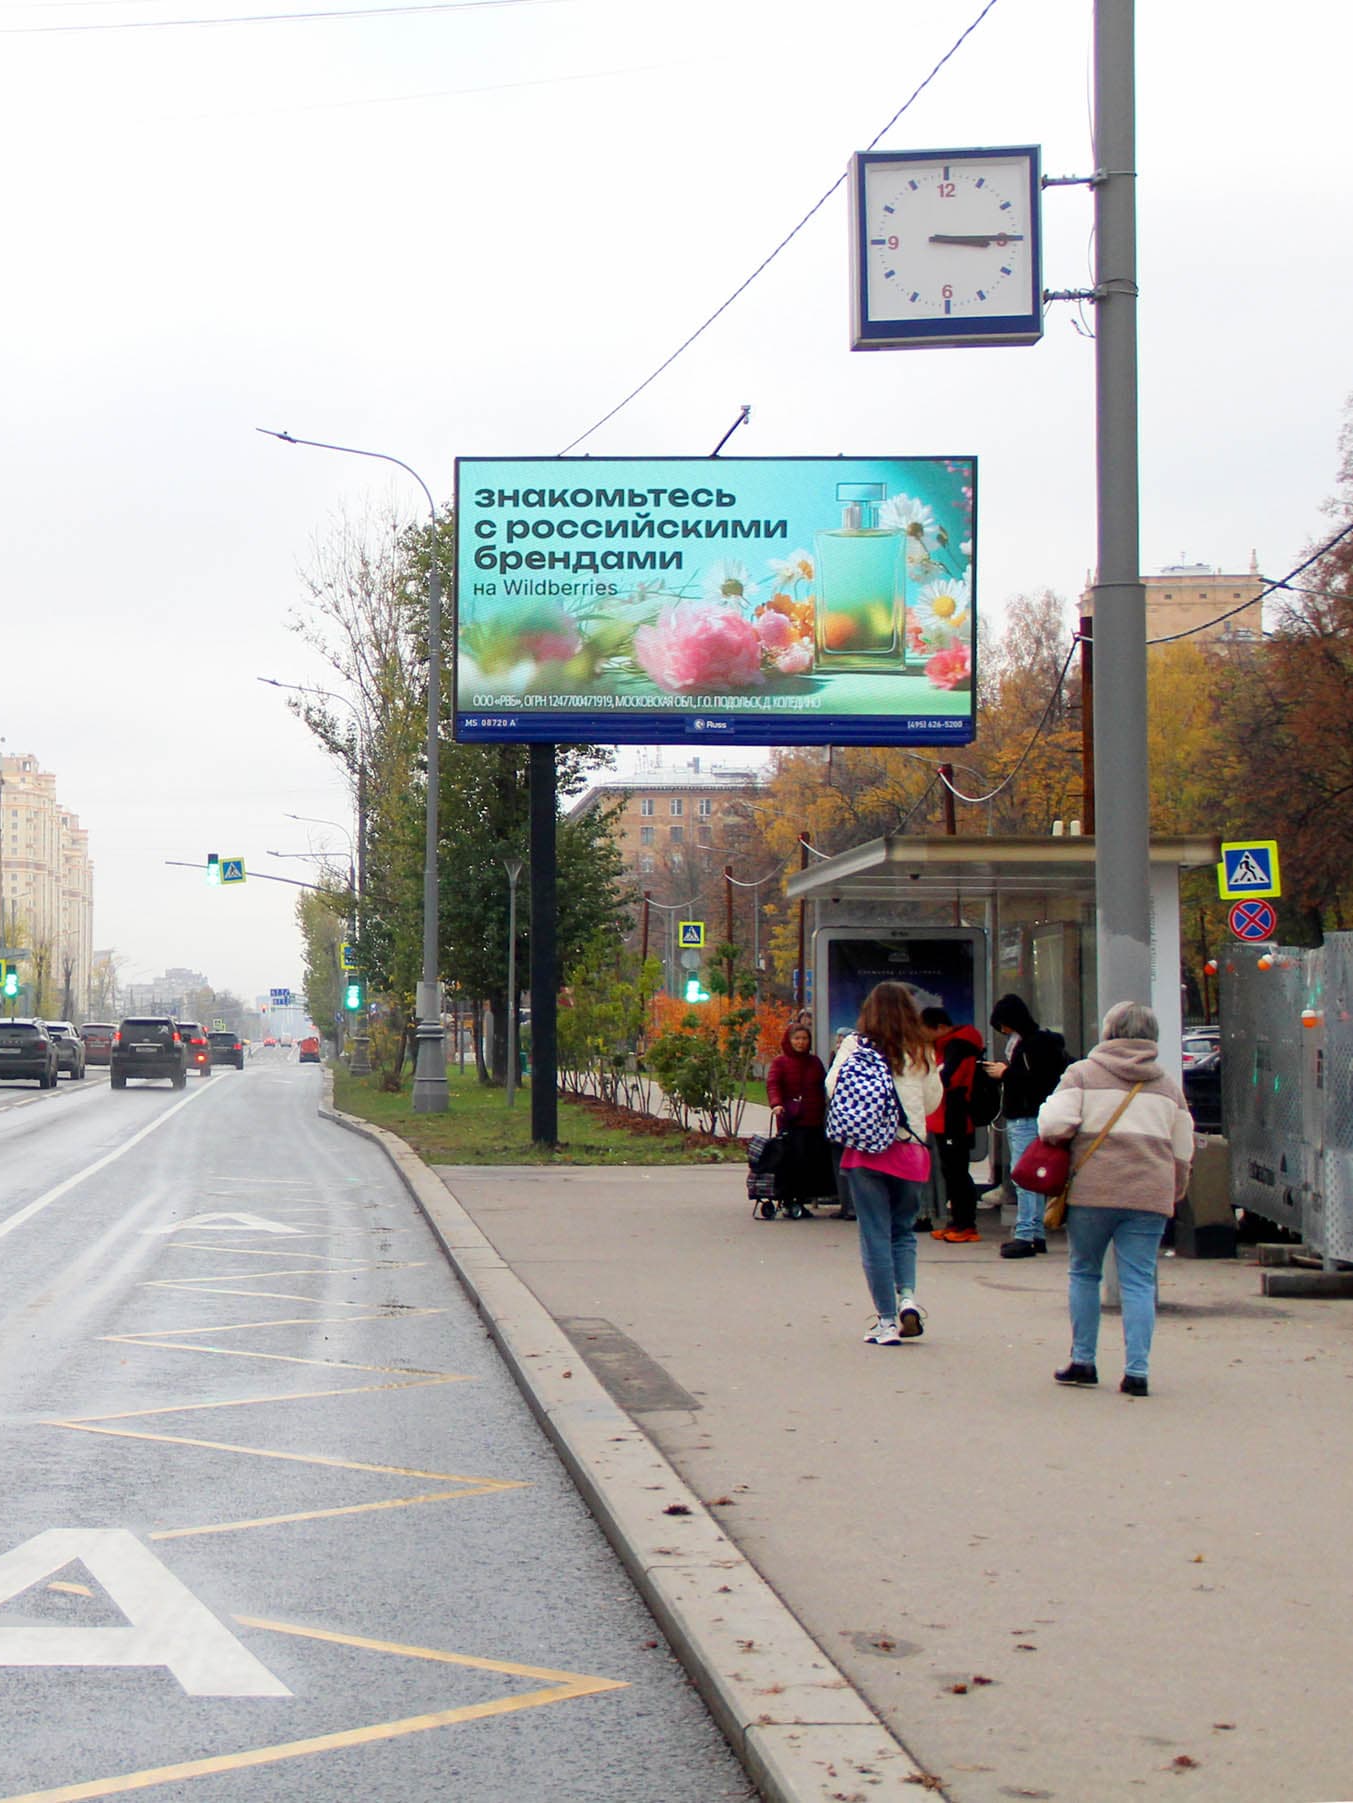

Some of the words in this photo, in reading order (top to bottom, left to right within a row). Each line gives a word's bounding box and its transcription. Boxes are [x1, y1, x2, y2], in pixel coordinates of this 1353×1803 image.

[937, 183, 956, 198] 12
[887, 235, 899, 250] 9
[941, 284, 953, 299] 6
[474, 487, 737, 508] знакомьтесь
[474, 519, 497, 539] с
[506, 512, 788, 543] российскими
[474, 544, 683, 574] брендами
[473, 581, 497, 596] на
[503, 579, 618, 596] Wildberries
[524, 695, 547, 707] ОГРН
[615, 695, 674, 708] МОСКОВСКАЯ
[706, 720, 728, 729] Russ
